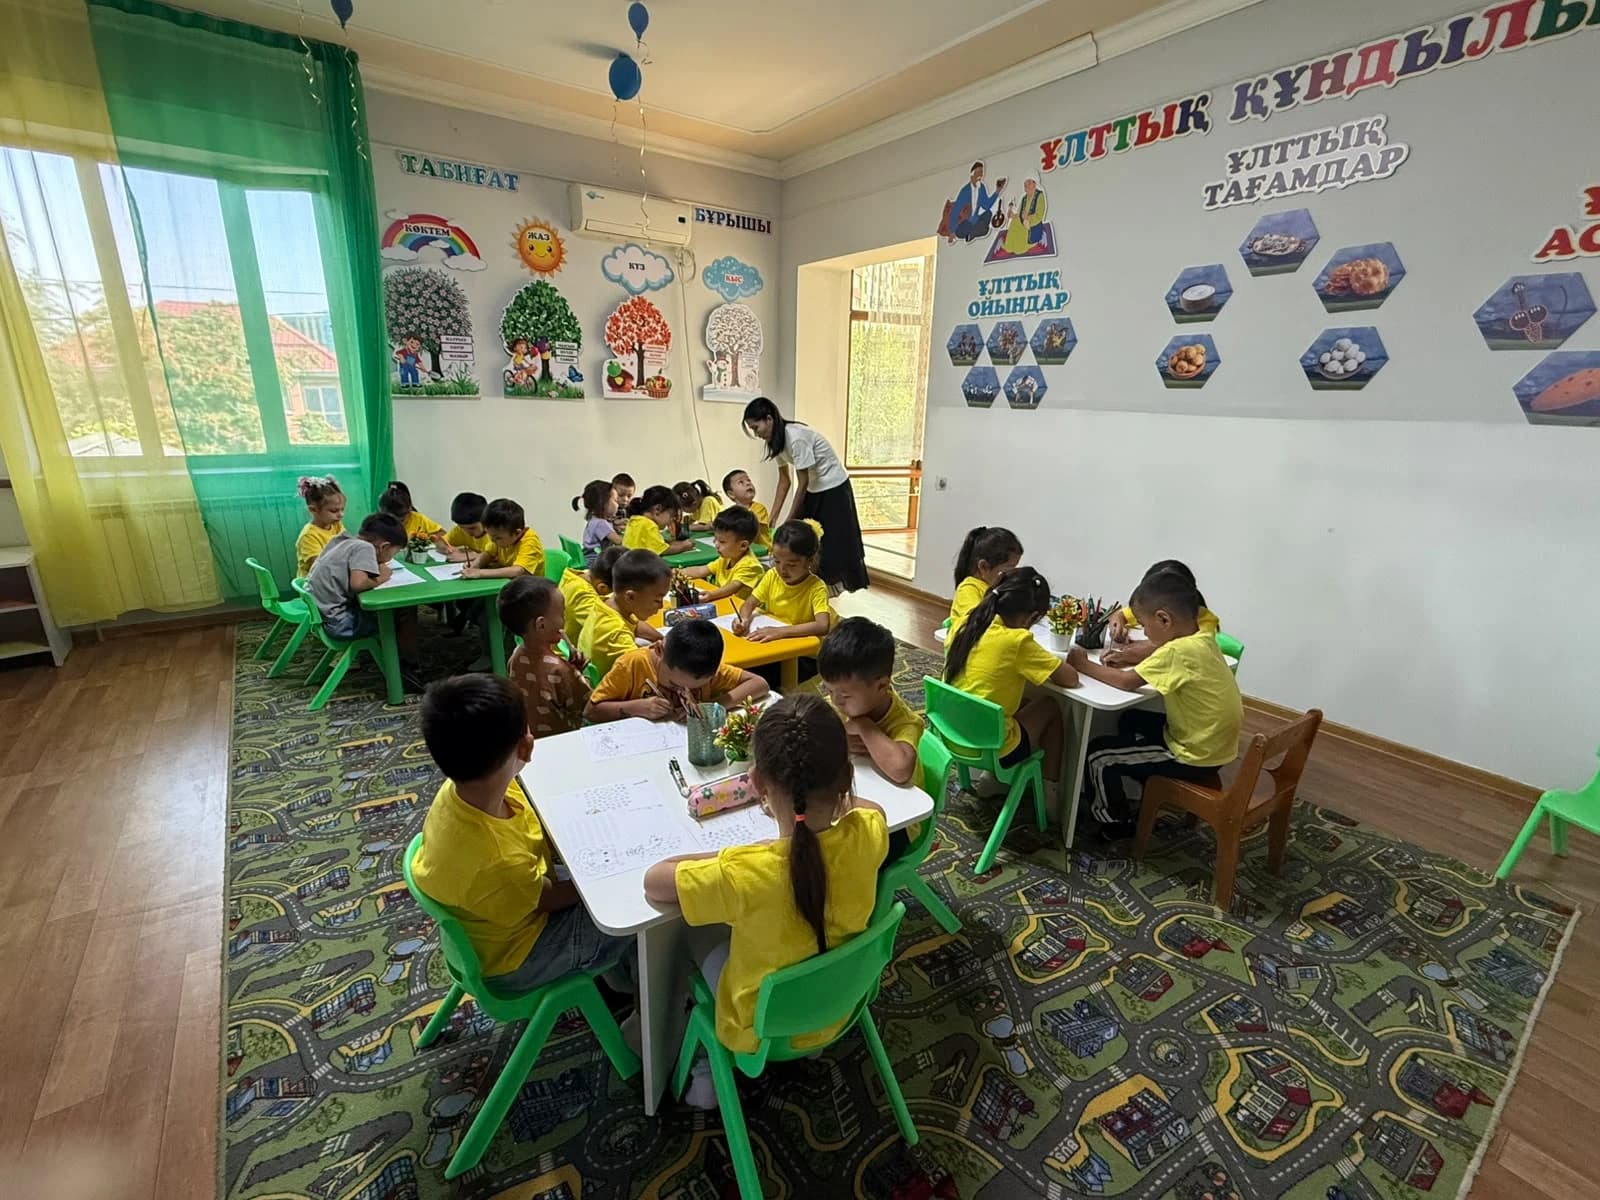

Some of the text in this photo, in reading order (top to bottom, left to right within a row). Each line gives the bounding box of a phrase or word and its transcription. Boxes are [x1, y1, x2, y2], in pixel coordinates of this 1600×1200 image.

[1040, 94, 1209, 171] ҰЛТТЫҚ
[1228, 118, 1383, 174] ҰЛТТЫҚ
[1205, 147, 1404, 207] ТАҒАМДАР
[695, 207, 772, 234] БҰРЫШЫ
[978, 271, 1060, 296] ҰЛТТЫҚ
[968, 292, 1068, 317] ОЙЫНДАР
